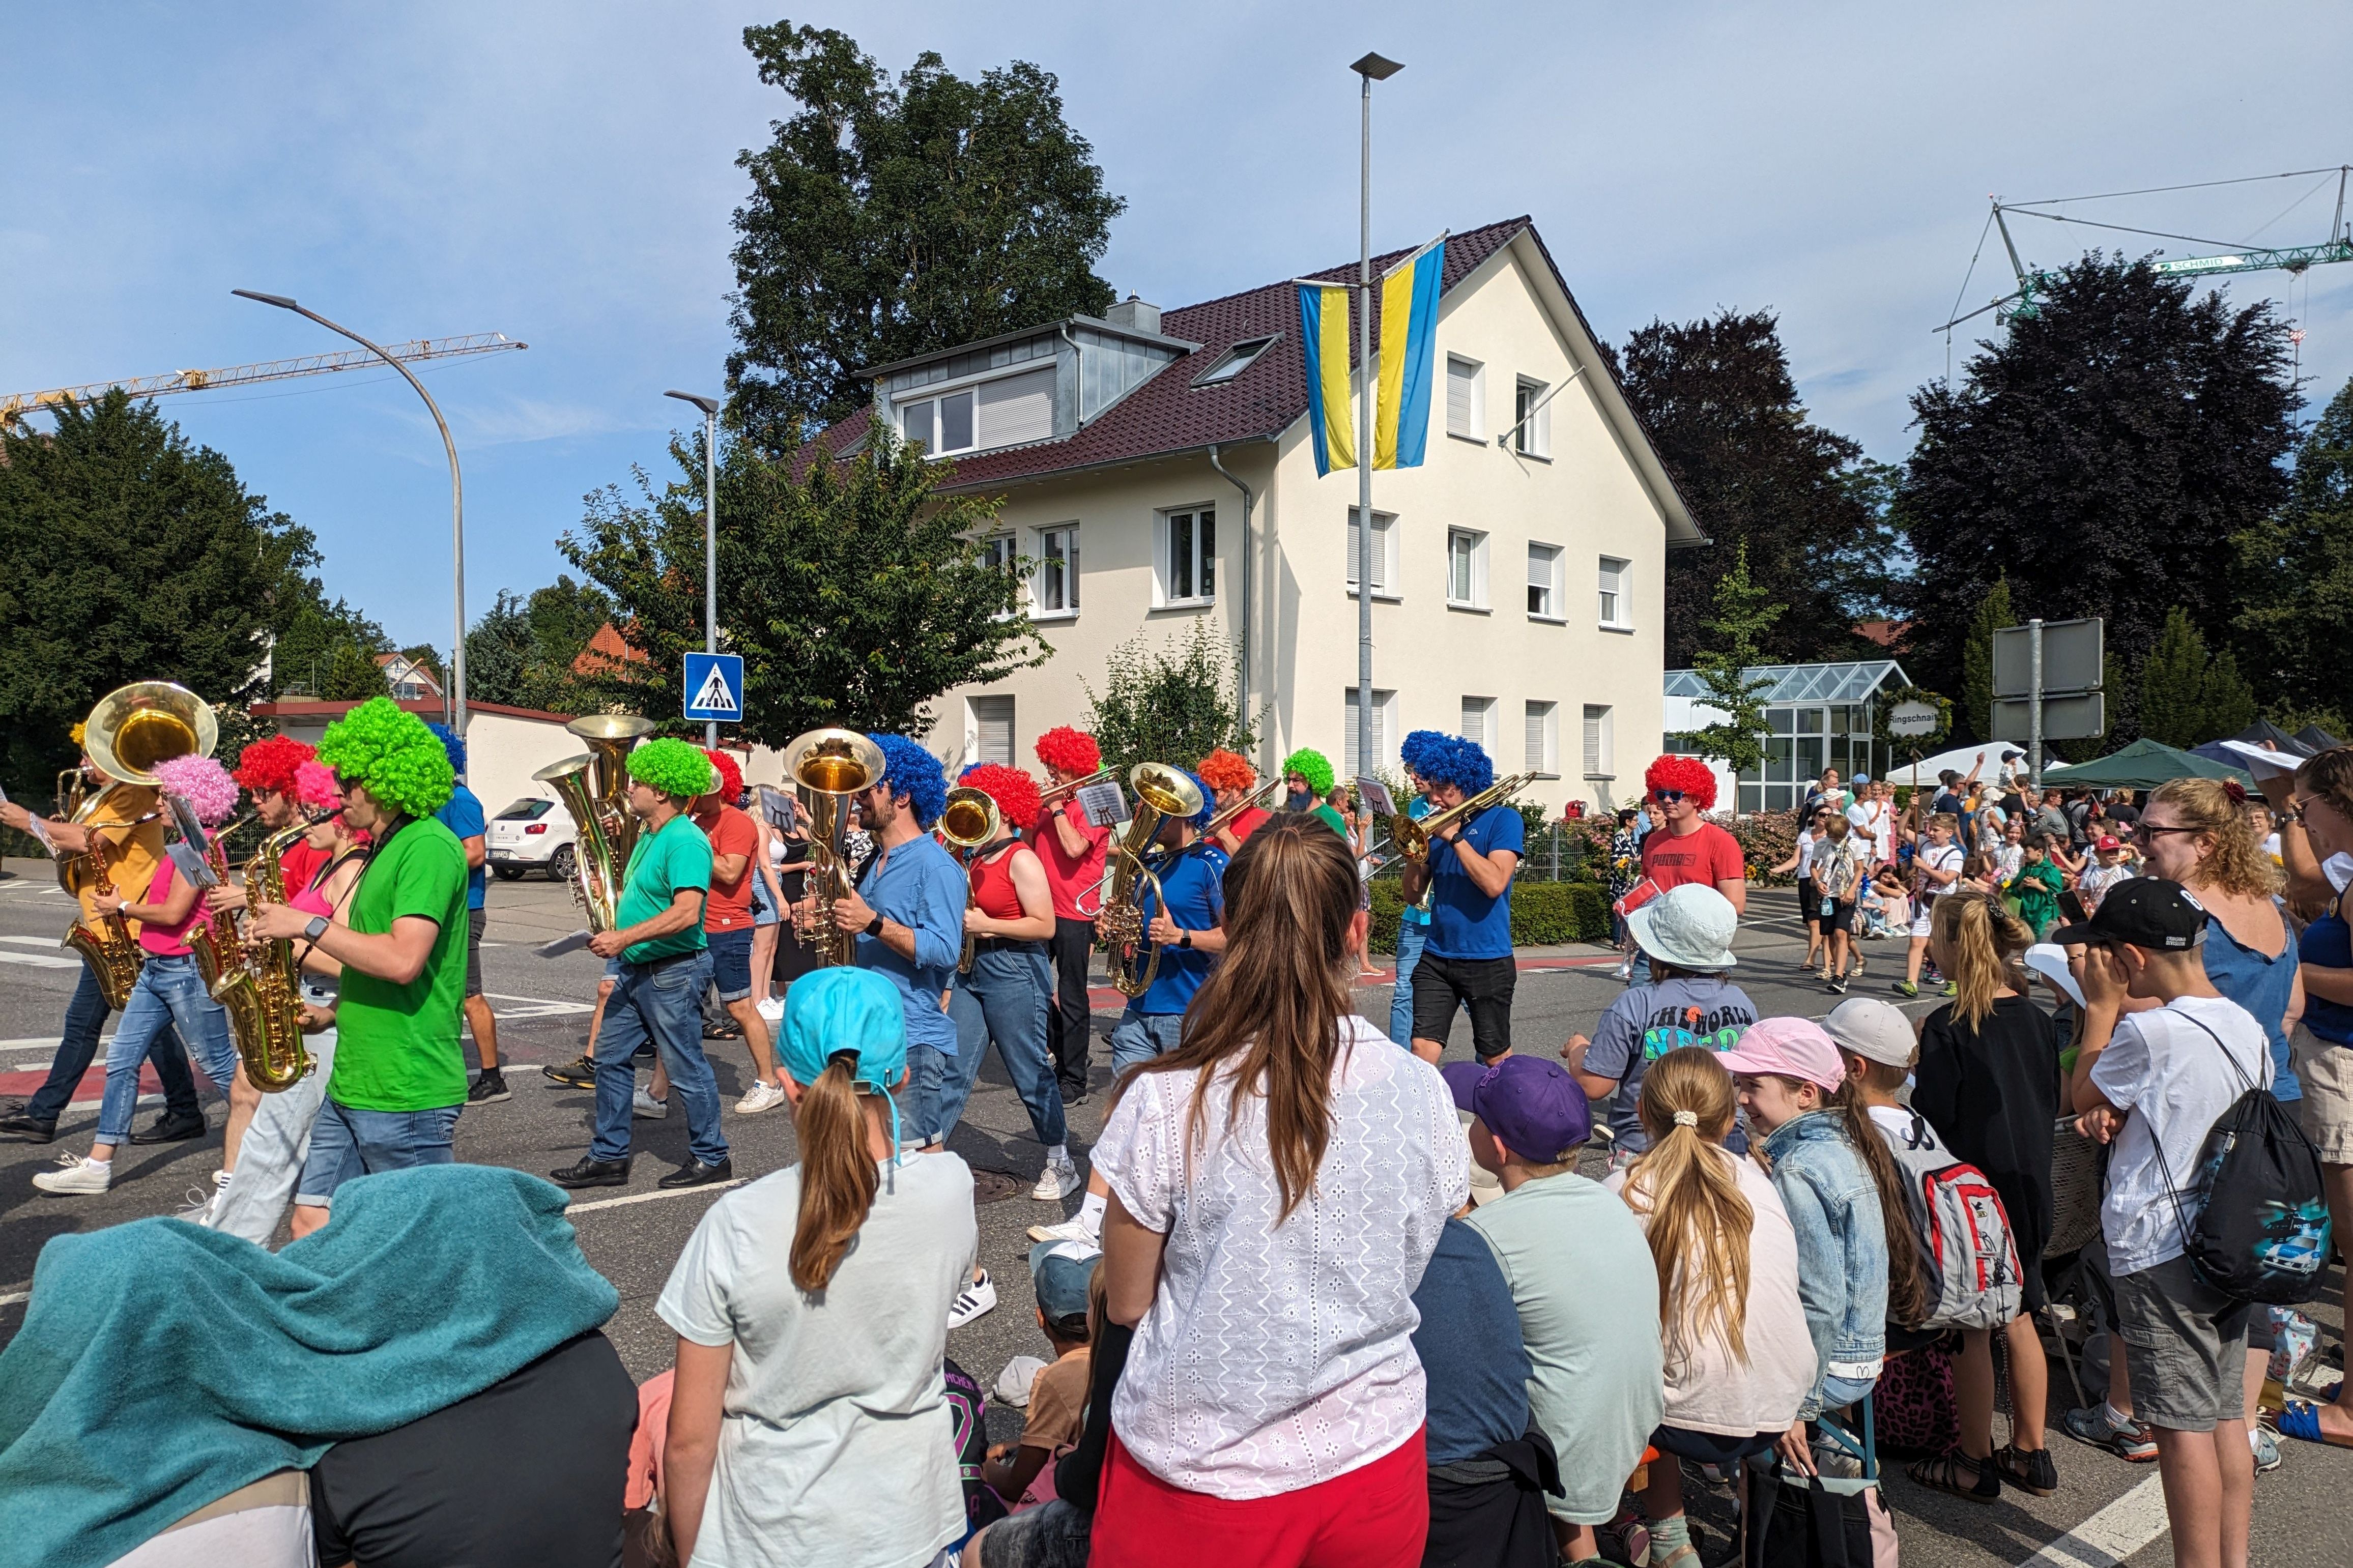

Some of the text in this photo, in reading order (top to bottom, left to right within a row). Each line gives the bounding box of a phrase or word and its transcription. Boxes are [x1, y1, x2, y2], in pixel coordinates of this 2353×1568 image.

[2174, 259, 2223, 270] SCHMID
[1889, 713, 1938, 724] Ringschnait
[1652, 853, 1684, 867] PUMA
[1647, 1005, 1753, 1036] THE WORLD
